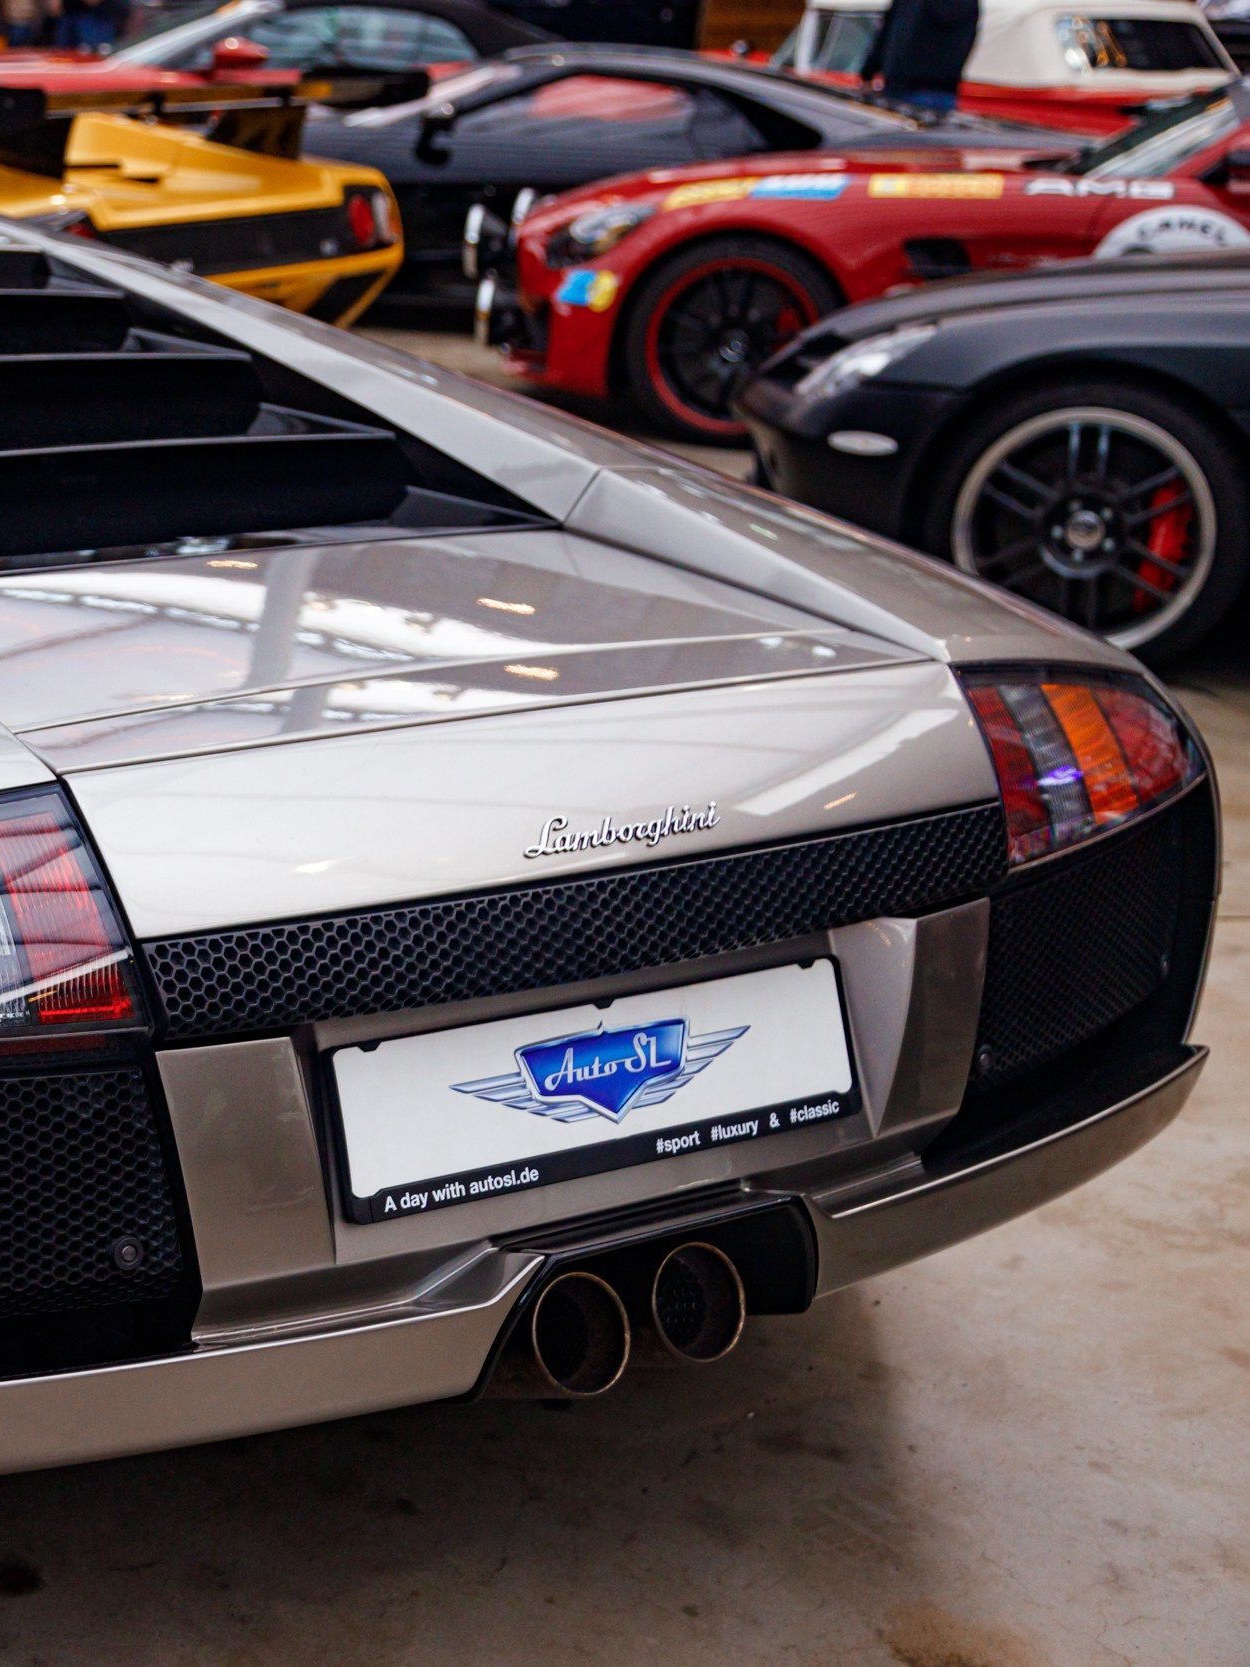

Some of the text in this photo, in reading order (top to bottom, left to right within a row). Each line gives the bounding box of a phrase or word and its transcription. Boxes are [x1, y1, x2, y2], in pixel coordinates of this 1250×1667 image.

[523, 801, 721, 858] Lamborghini
[384, 1099, 840, 1213] A day with autosl.de #sport #luxury & #classic
